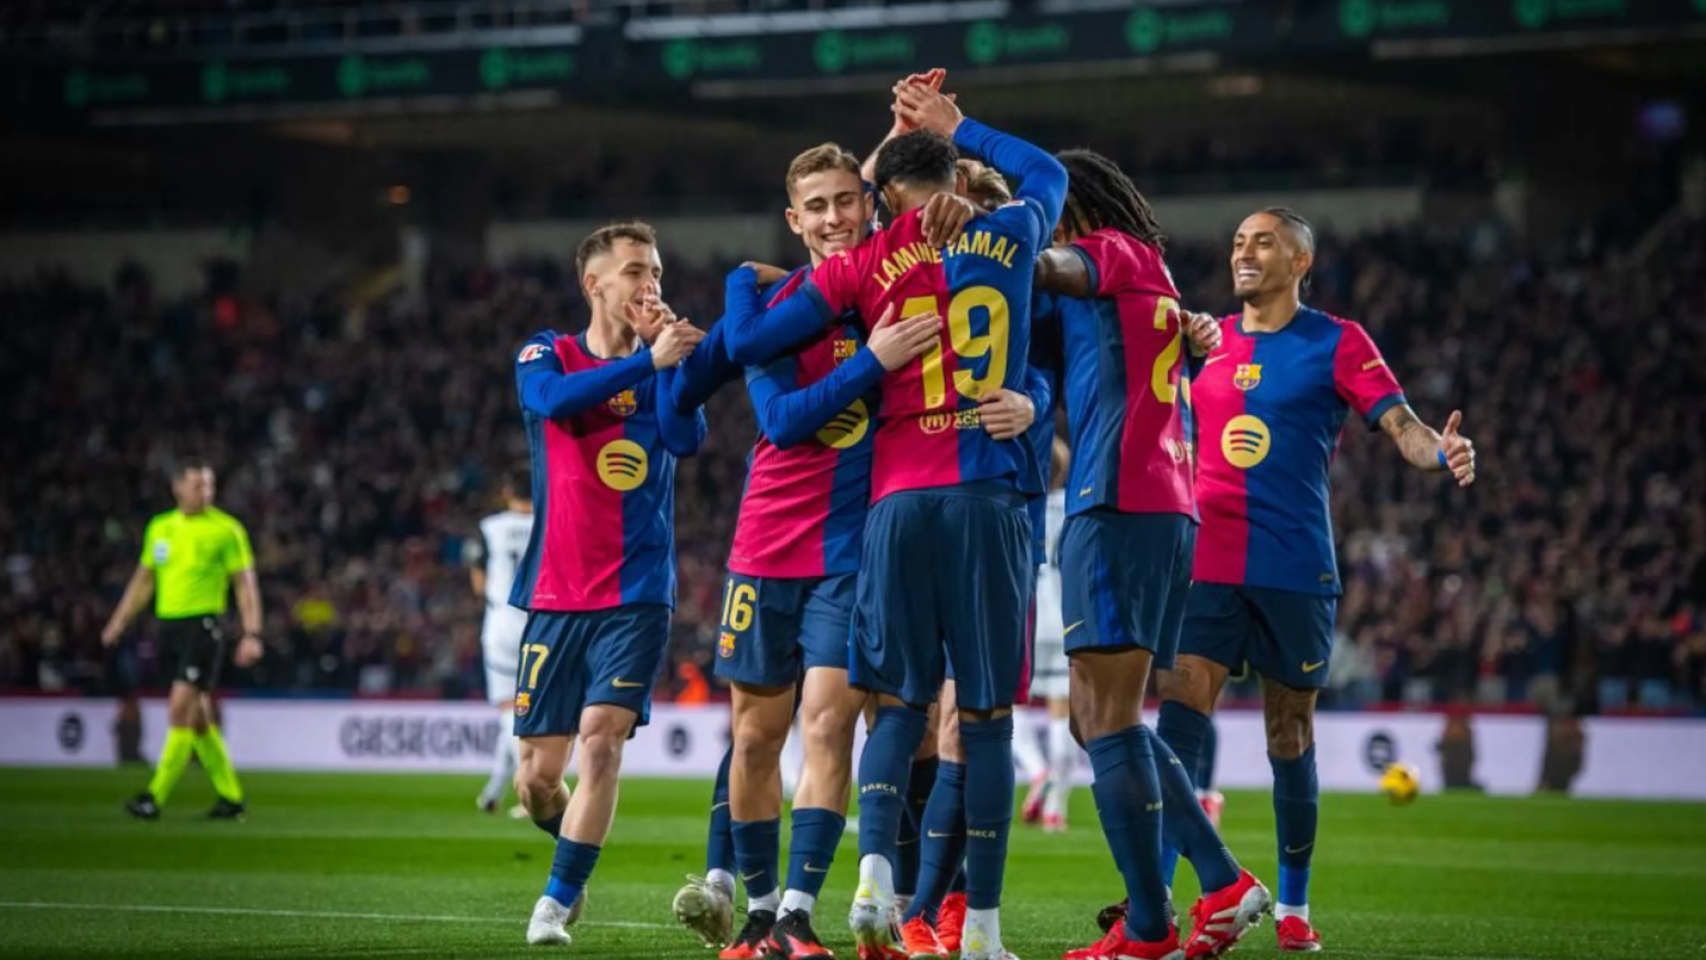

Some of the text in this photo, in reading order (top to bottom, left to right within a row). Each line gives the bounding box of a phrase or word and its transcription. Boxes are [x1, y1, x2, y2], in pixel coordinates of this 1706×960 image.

[873, 241, 943, 291] LAMINE
[900, 285, 1009, 409] 19
[721, 578, 756, 632] 16
[519, 643, 549, 689] 17
